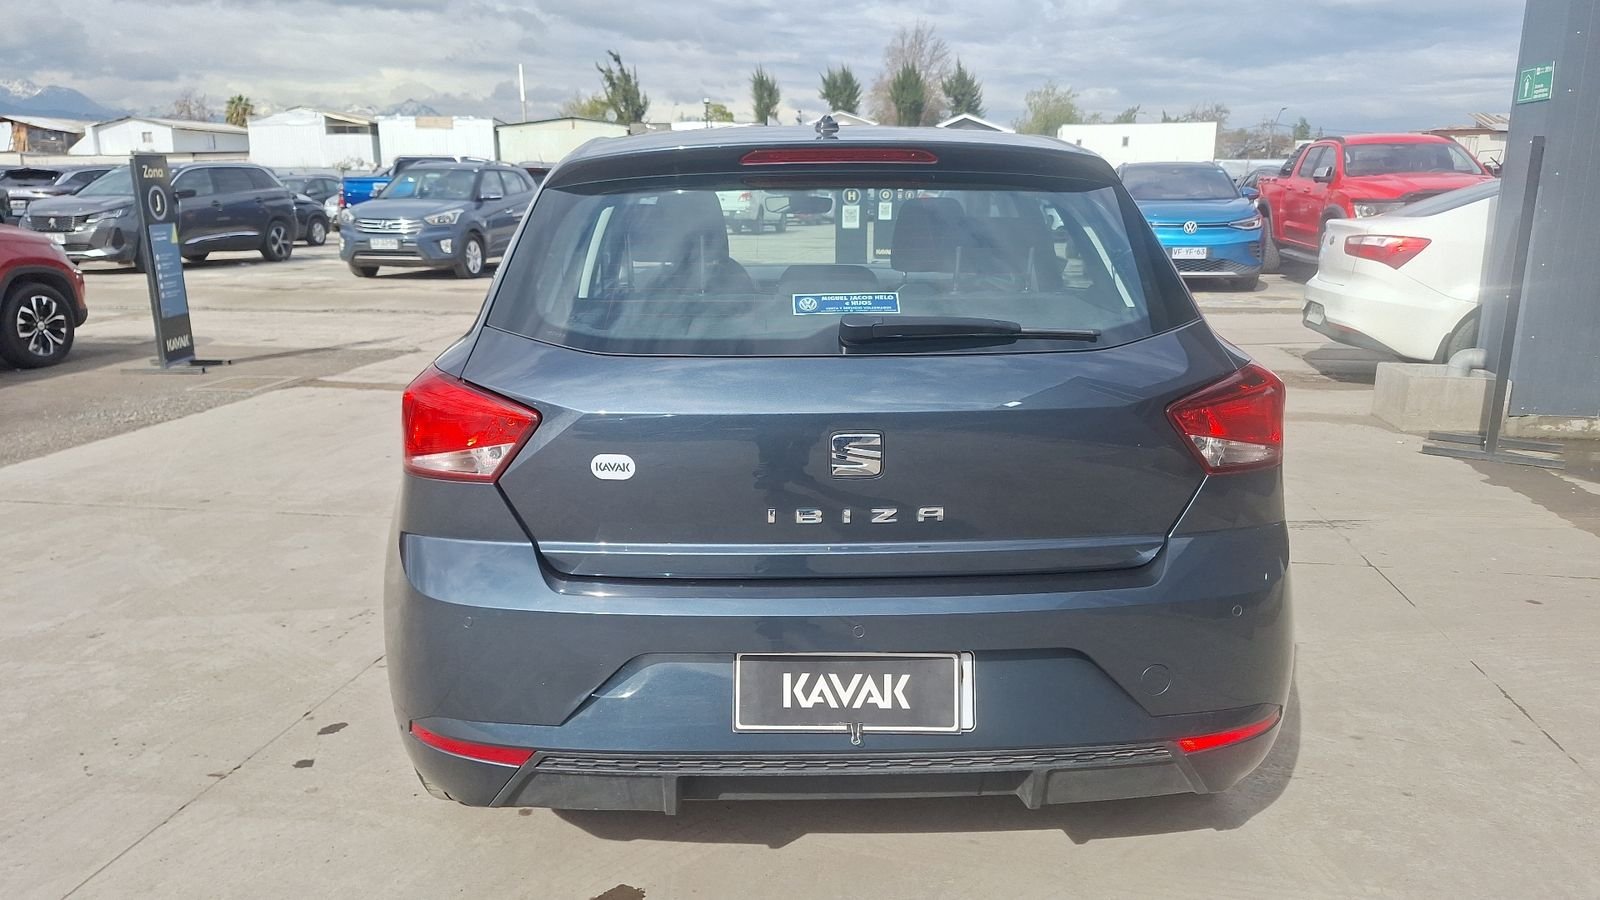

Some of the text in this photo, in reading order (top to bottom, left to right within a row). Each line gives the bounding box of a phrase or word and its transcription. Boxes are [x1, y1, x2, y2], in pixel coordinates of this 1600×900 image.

[142, 164, 164, 179] Zona
[848, 190, 856, 200] H
[166, 334, 191, 353] KAVAK
[595, 462, 630, 473] KAVAK
[767, 505, 945, 524] IBIZA
[783, 673, 911, 709] KAVAK
